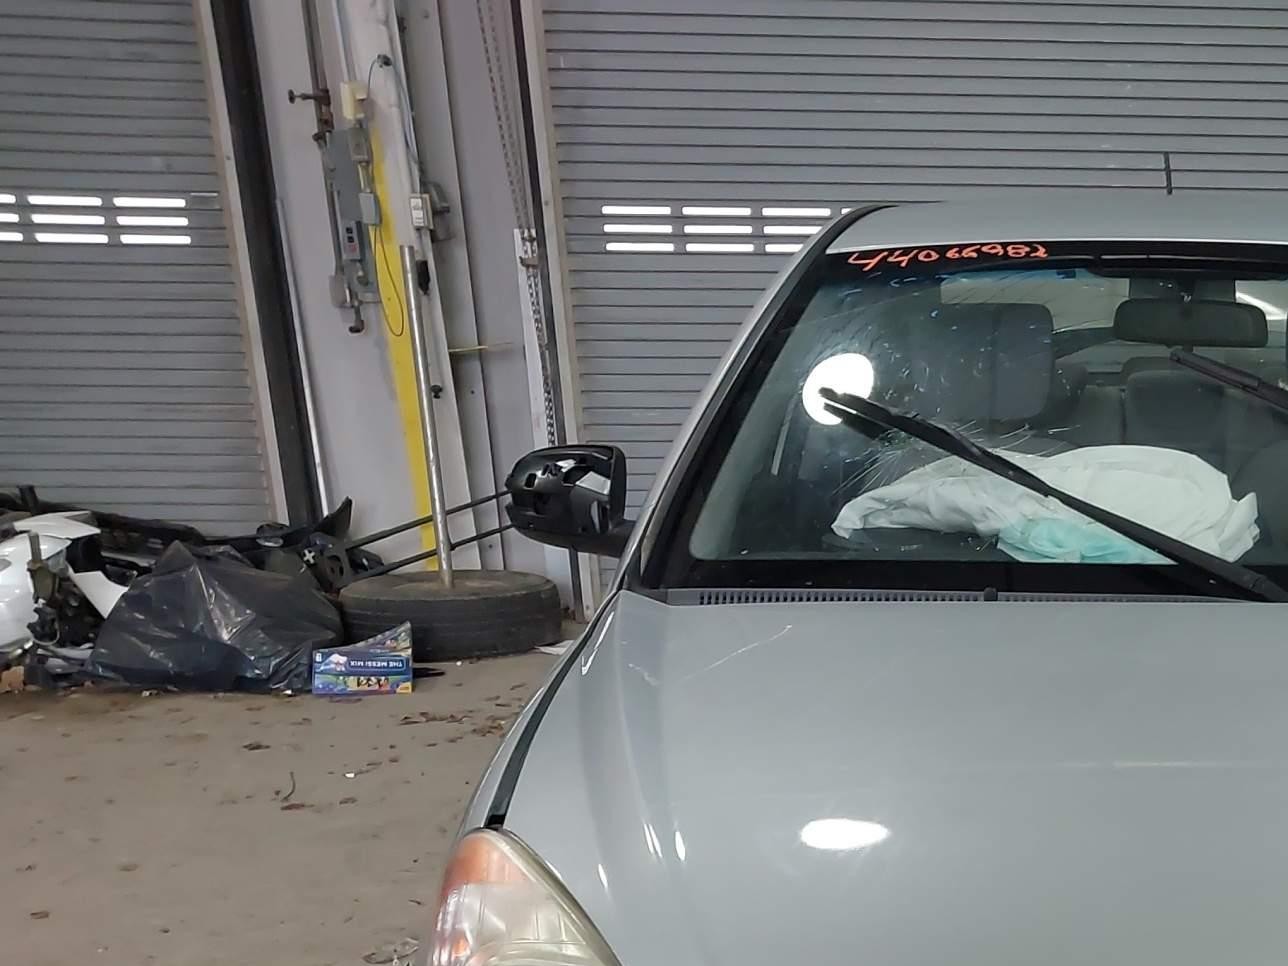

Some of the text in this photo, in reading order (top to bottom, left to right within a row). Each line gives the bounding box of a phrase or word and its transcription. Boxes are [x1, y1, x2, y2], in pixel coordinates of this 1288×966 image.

[847, 243, 1049, 272] 44066982
[365, 660, 388, 668] MESSI
[388, 660, 403, 668] THE
